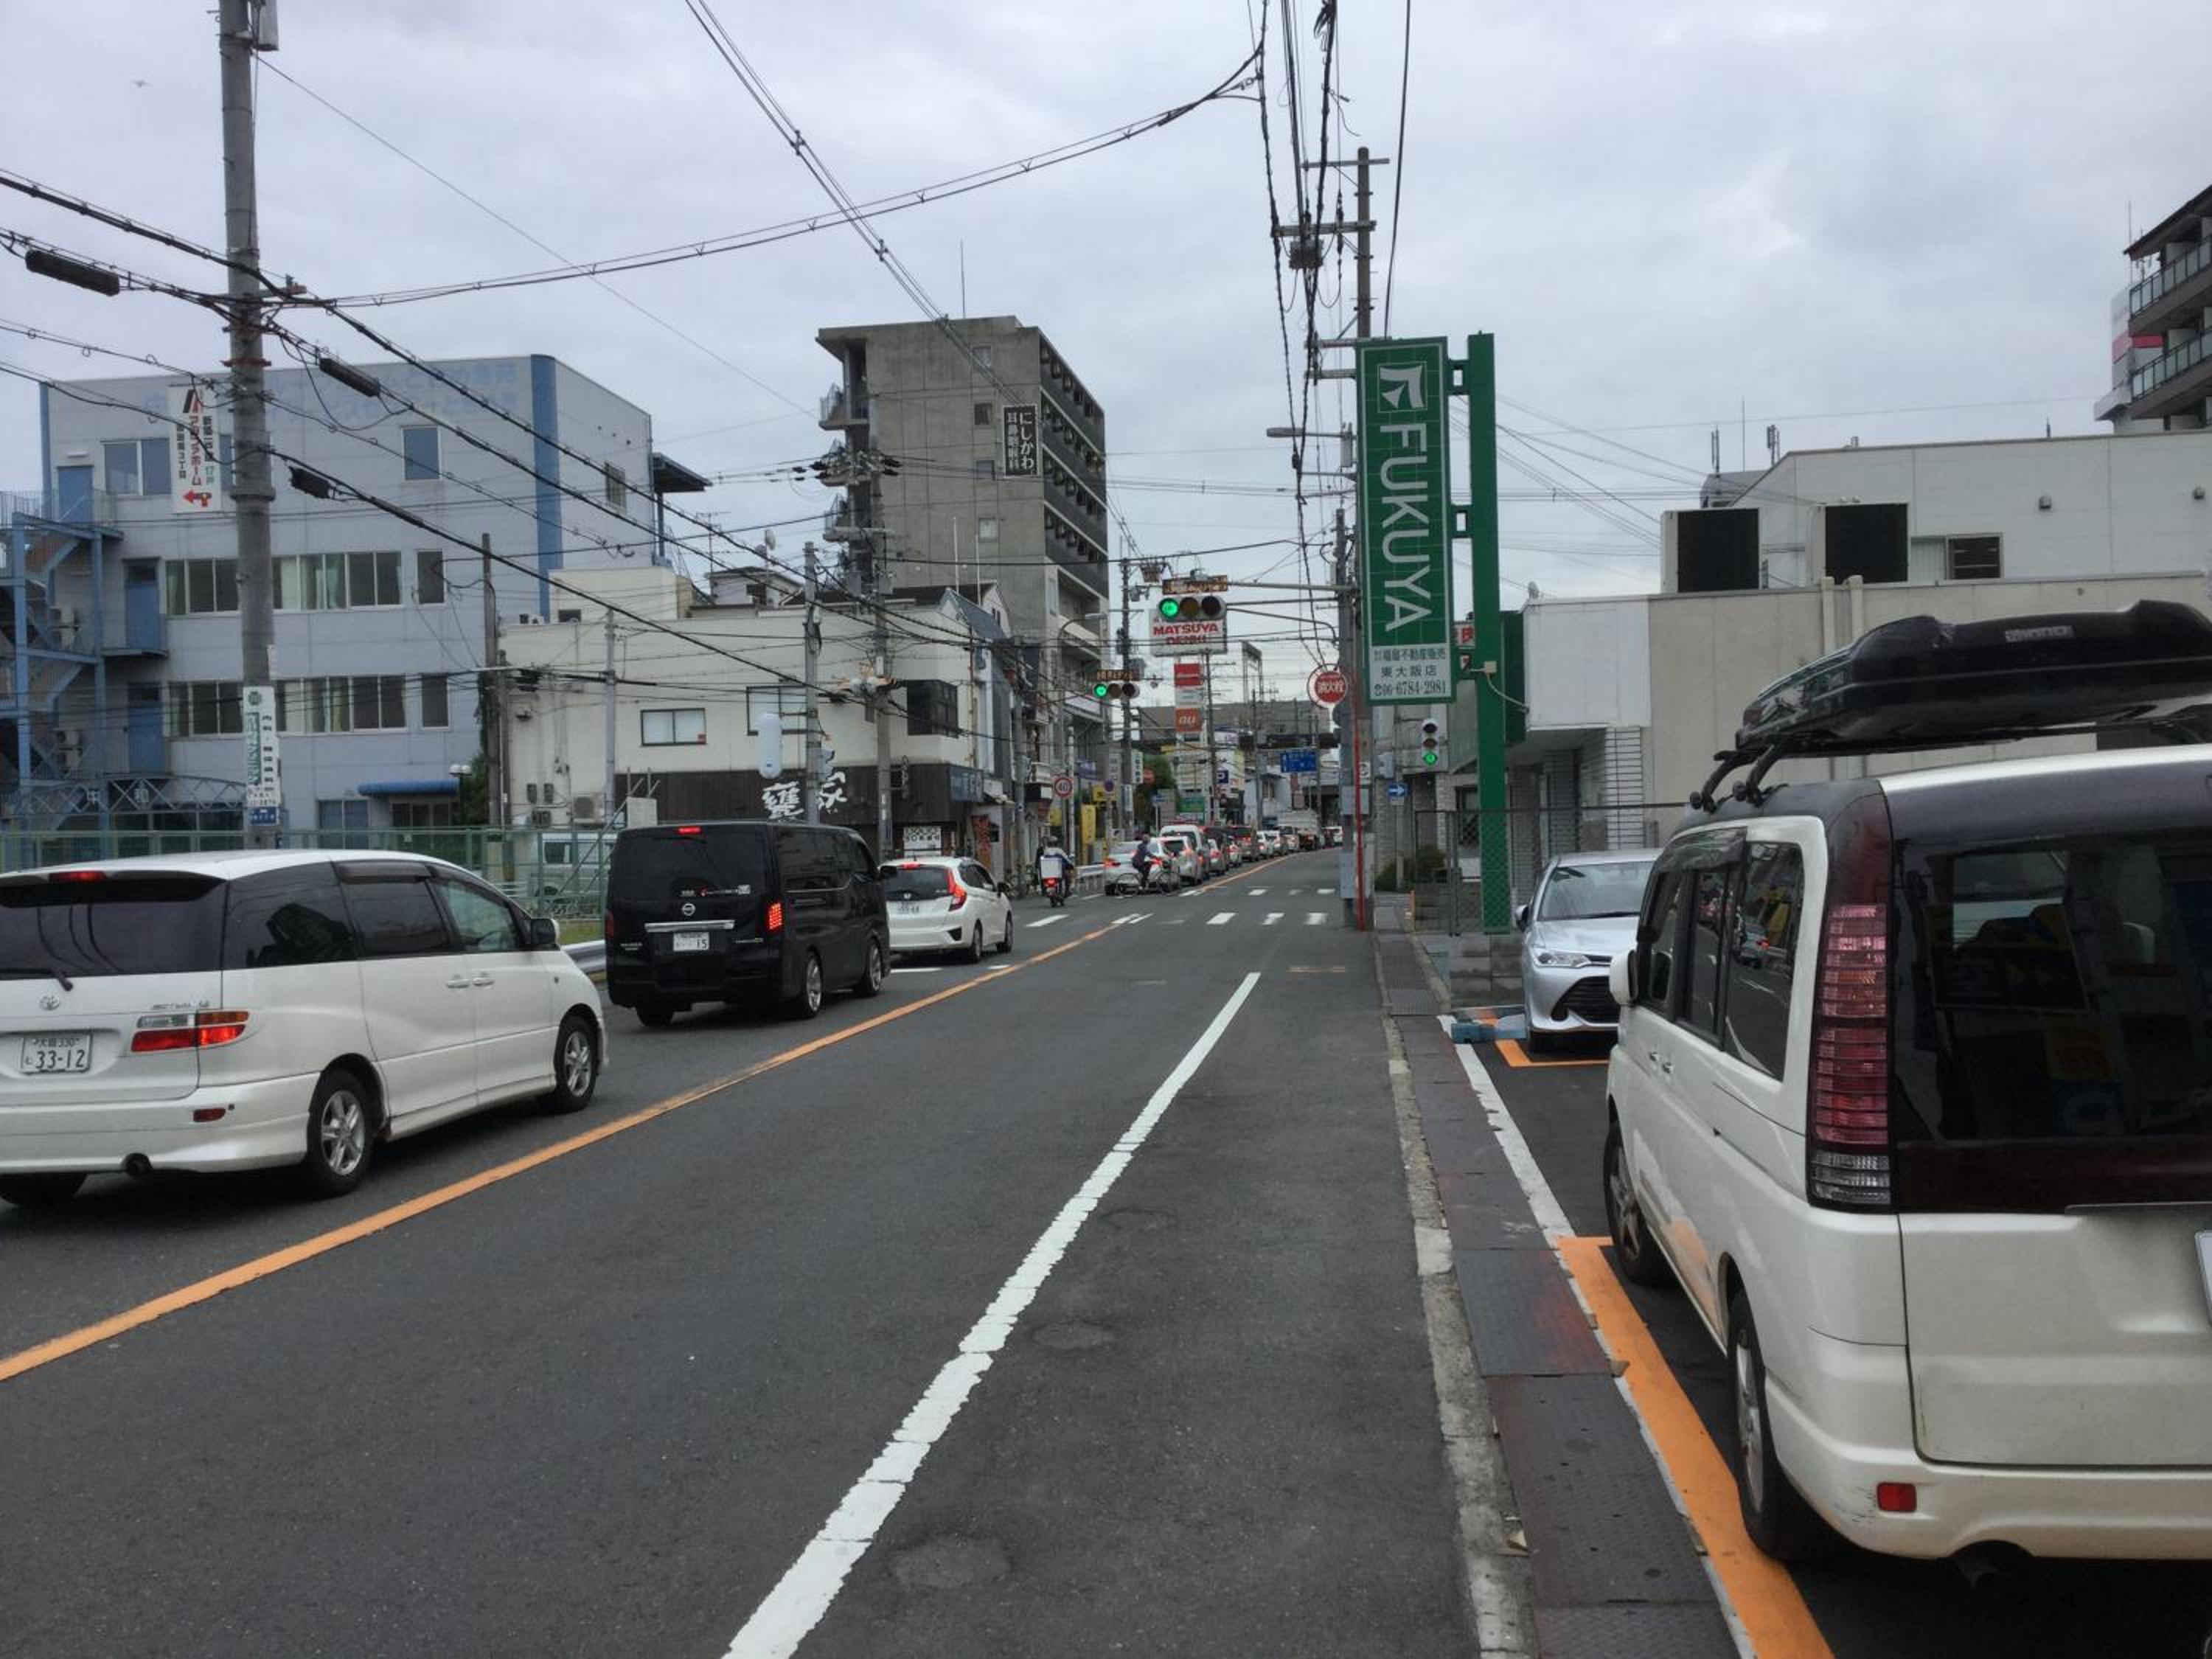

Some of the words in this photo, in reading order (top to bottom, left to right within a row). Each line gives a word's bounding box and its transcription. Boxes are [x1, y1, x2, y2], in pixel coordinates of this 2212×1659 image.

[1380, 424, 1433, 632] FUKUYA
[1153, 623, 1219, 636] MATSUYA
[1381, 665, 1438, 678] 東大阪店
[1179, 716, 1195, 726] au
[35, 1048, 86, 1069] 33-12
